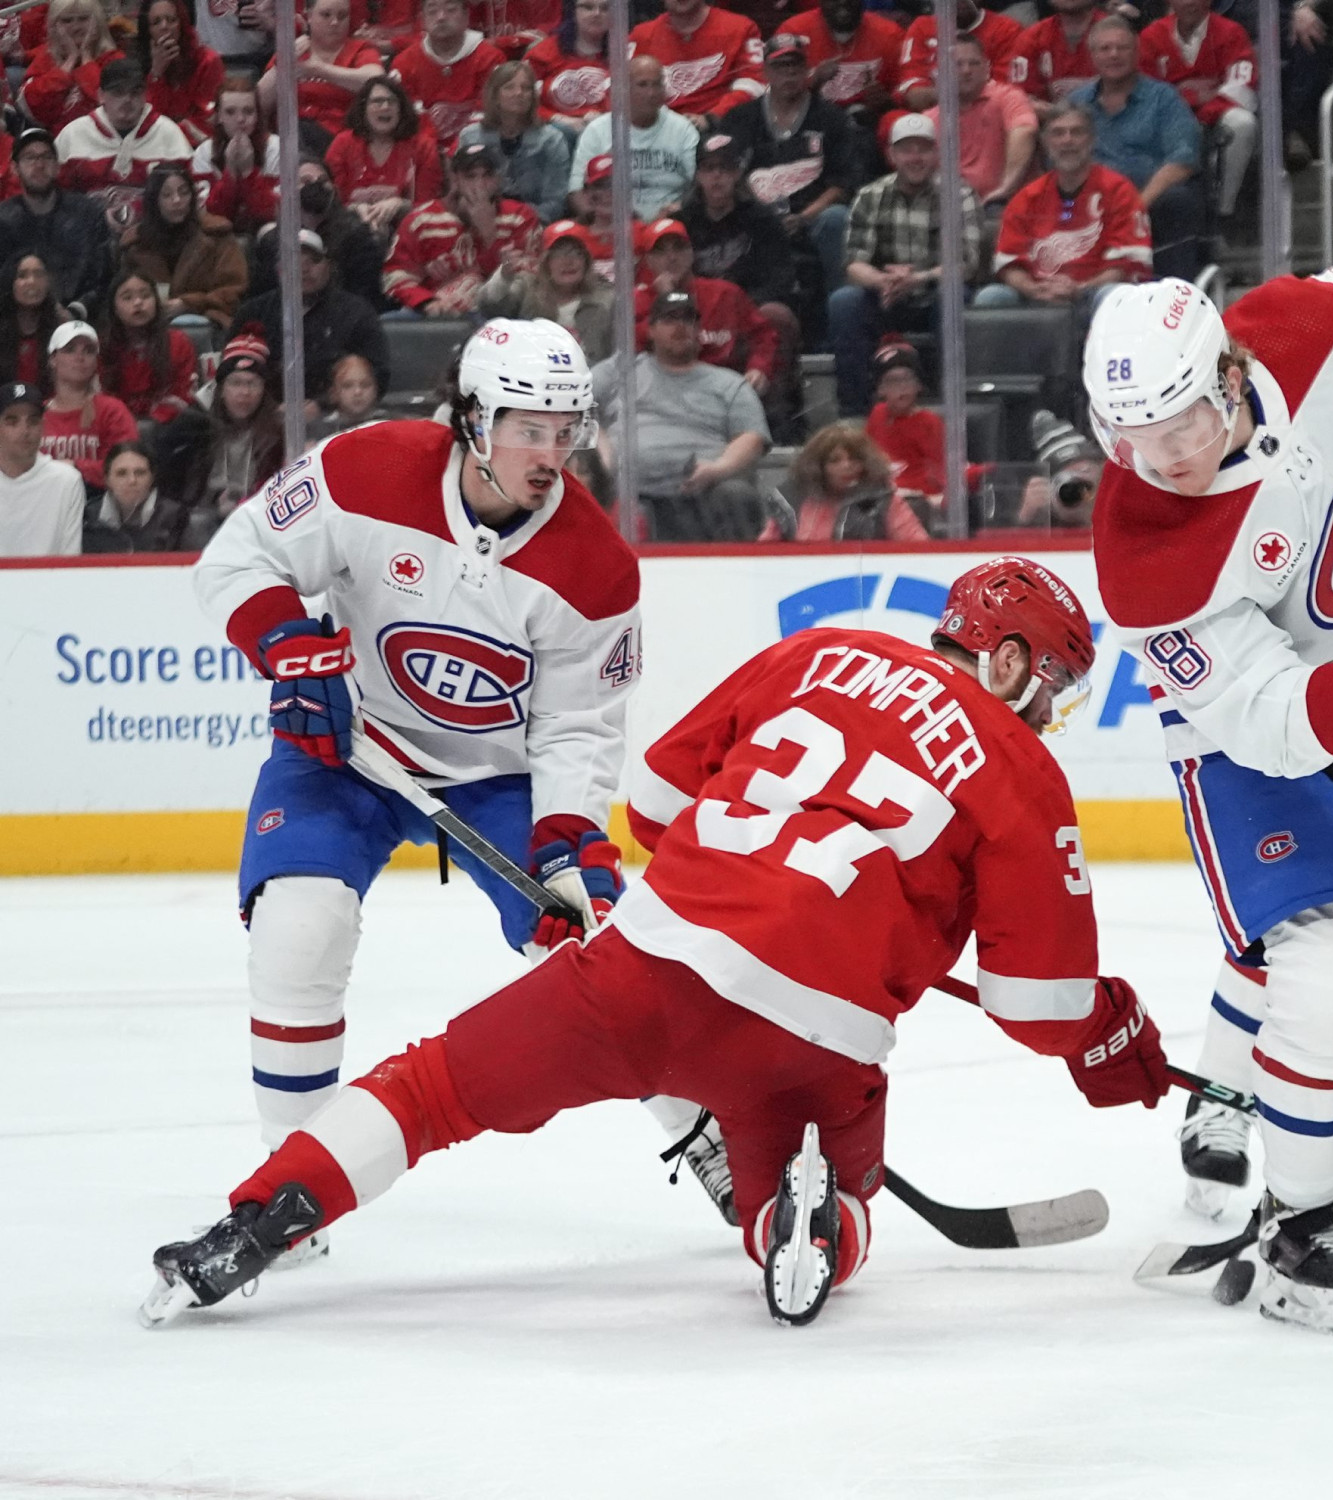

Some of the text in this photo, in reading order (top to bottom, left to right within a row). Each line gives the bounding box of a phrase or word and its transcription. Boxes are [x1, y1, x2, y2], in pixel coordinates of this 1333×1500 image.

[545, 383, 580, 391] CCM
[1107, 358, 1132, 382] 28
[1109, 398, 1147, 409] CCM
[1286, 541, 1308, 575] CANADA
[391, 583, 424, 598] CANADA
[1034, 567, 1079, 616] meijer
[56, 632, 264, 685] Score en
[600, 627, 643, 688] 4
[790, 646, 986, 798] COMPHER
[695, 706, 957, 899] 37
[541, 854, 570, 873] CCM
